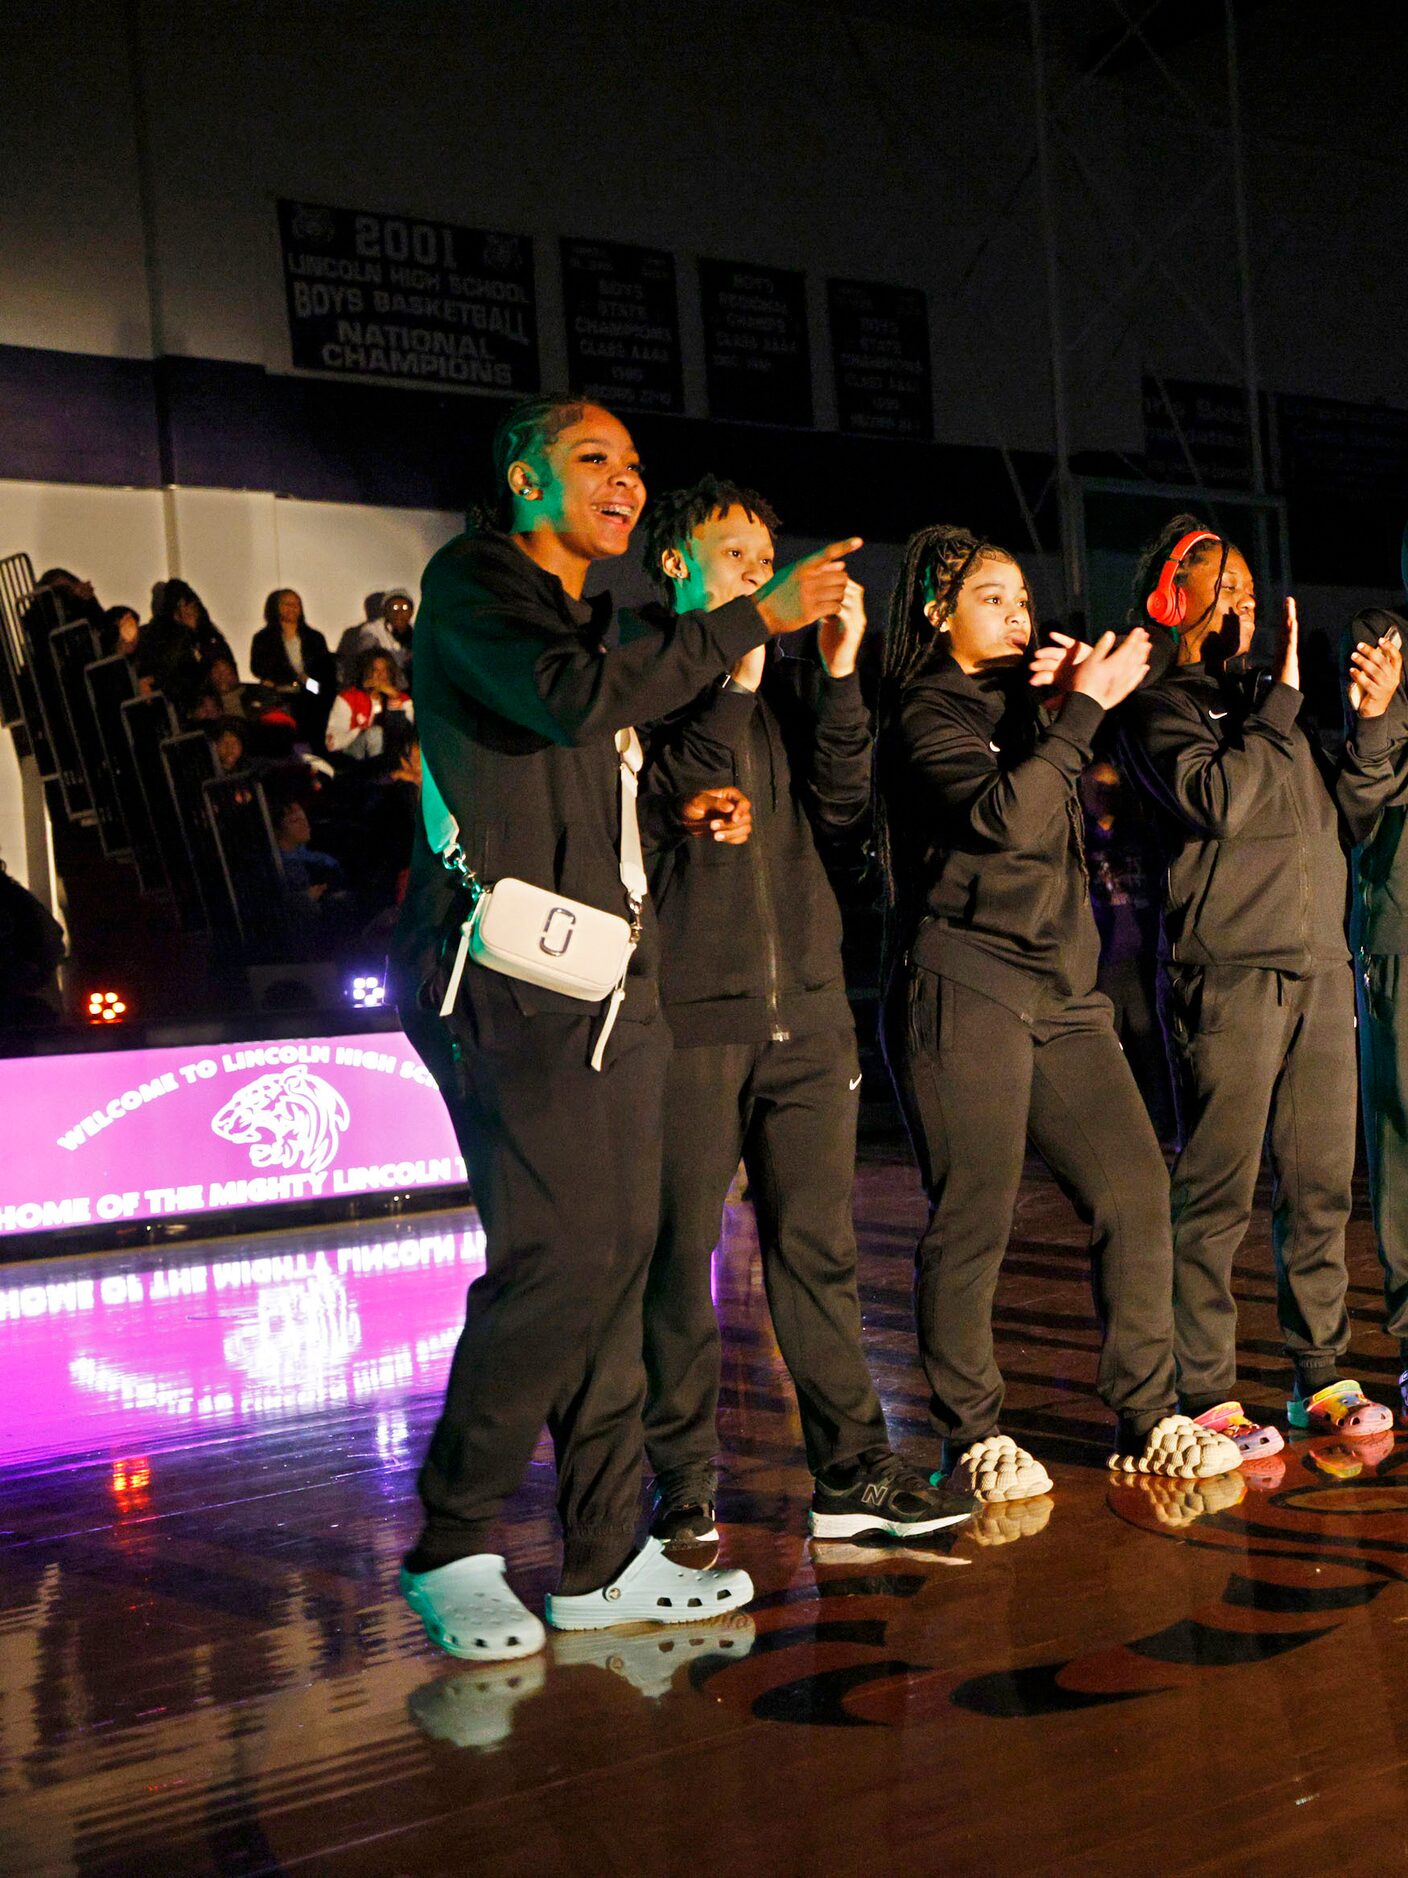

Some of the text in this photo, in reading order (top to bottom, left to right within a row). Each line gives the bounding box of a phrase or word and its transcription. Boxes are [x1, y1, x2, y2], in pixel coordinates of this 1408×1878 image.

[354, 215, 457, 269] 2001
[287, 252, 531, 304] LINCOLN HIGH SCHOOL
[293, 281, 531, 346] BOYS BASKETBALL
[338, 319, 495, 358] NATIONAL
[321, 343, 513, 386] CHAMPIONS
[57, 1072, 179, 1151] WELCOME
[179, 1059, 218, 1083] TO
[222, 1045, 330, 1073] LINCOLN
[335, 1047, 397, 1074] HIGH
[0, 1198, 91, 1231] HOME
[97, 1192, 140, 1220] OF
[144, 1185, 204, 1214] THE
[209, 1171, 328, 1207] MIGHTY
[333, 1157, 451, 1193] LINCOLN
